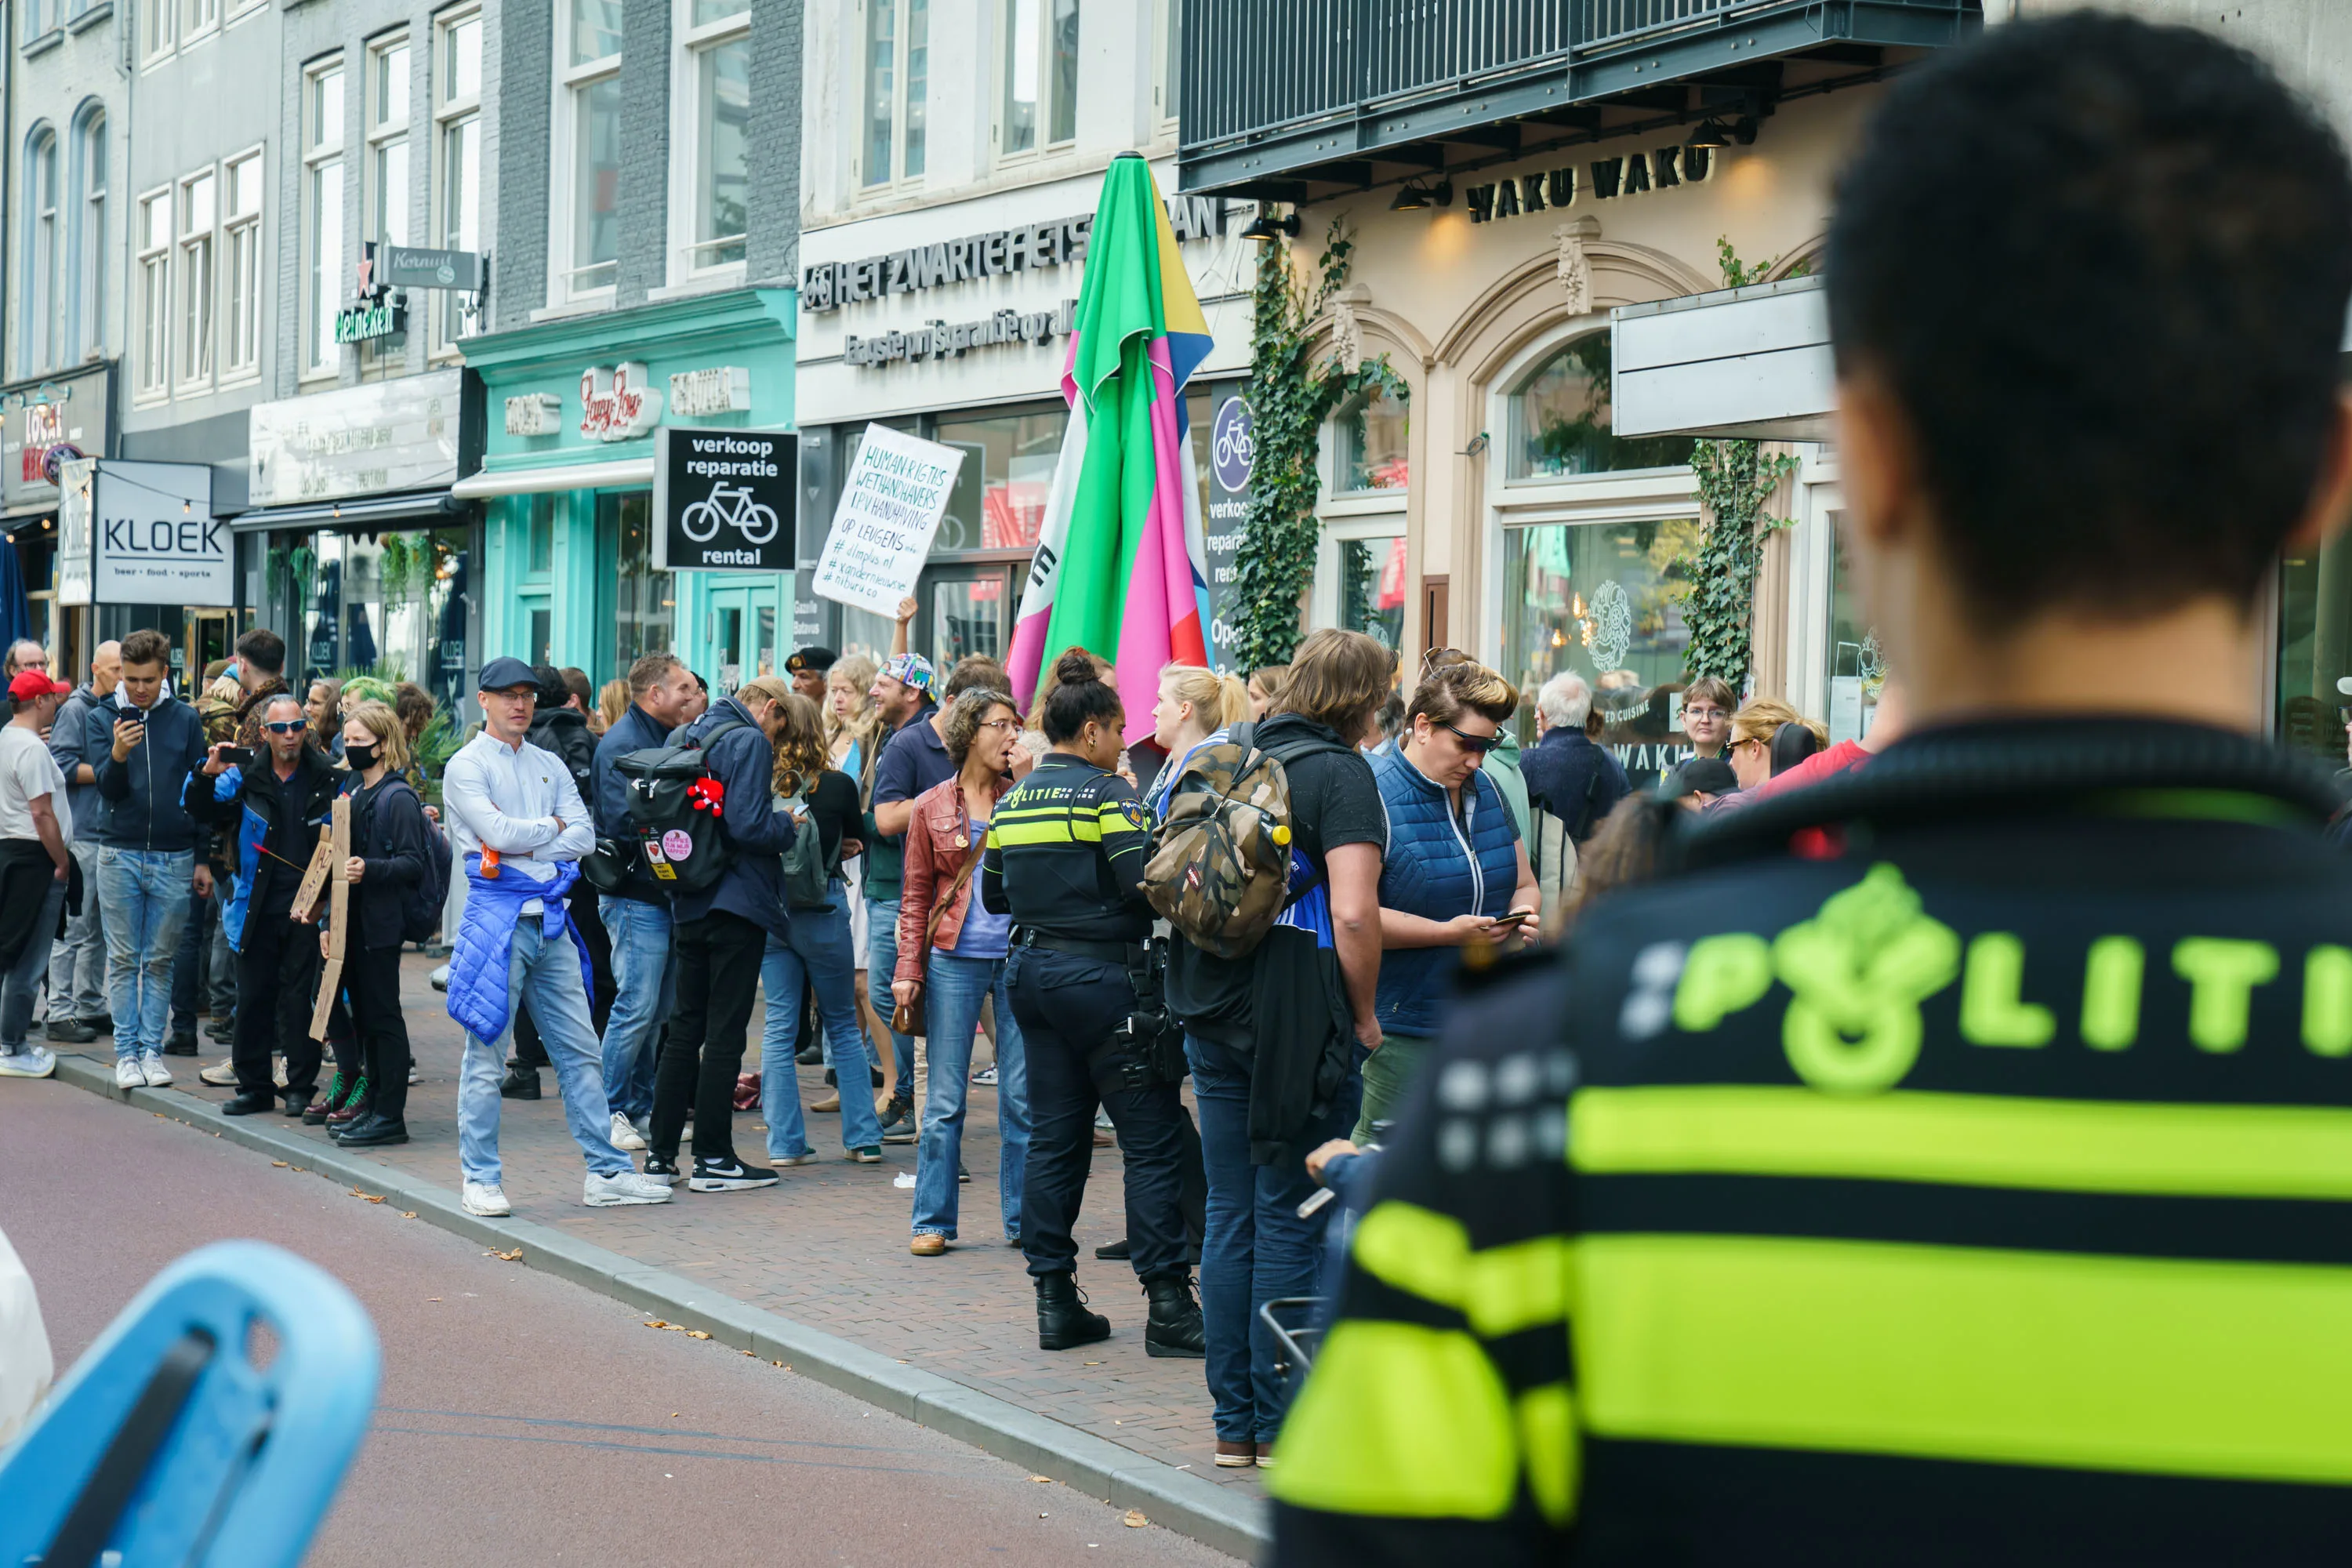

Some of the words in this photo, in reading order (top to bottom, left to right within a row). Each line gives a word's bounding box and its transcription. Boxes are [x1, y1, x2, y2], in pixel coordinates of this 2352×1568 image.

[1466, 167, 1573, 223] WAKU
[1591, 146, 1711, 199] WAKU
[836, 256, 887, 303] HET
[887, 231, 1005, 292] ZWARTE
[336, 297, 394, 343] Heineken
[844, 331, 904, 368] laagste
[1021, 313, 1047, 346] op
[692, 437, 773, 458] verkoop
[687, 460, 778, 477] reparatie
[856, 470, 938, 510] WETHANDHAVERS
[871, 498, 930, 531] HANDHAVING
[1210, 498, 1248, 519] verkoo
[105, 519, 223, 554] KLOEK
[842, 518, 855, 534] OP
[858, 524, 906, 550] LEUGENS
[702, 549, 760, 564] rental
[441, 641, 464, 659] KLOEK
[1617, 699, 1650, 722] CUISINE
[1006, 784, 1062, 809] POLITIE
[1672, 927, 2352, 1094] POLITI
